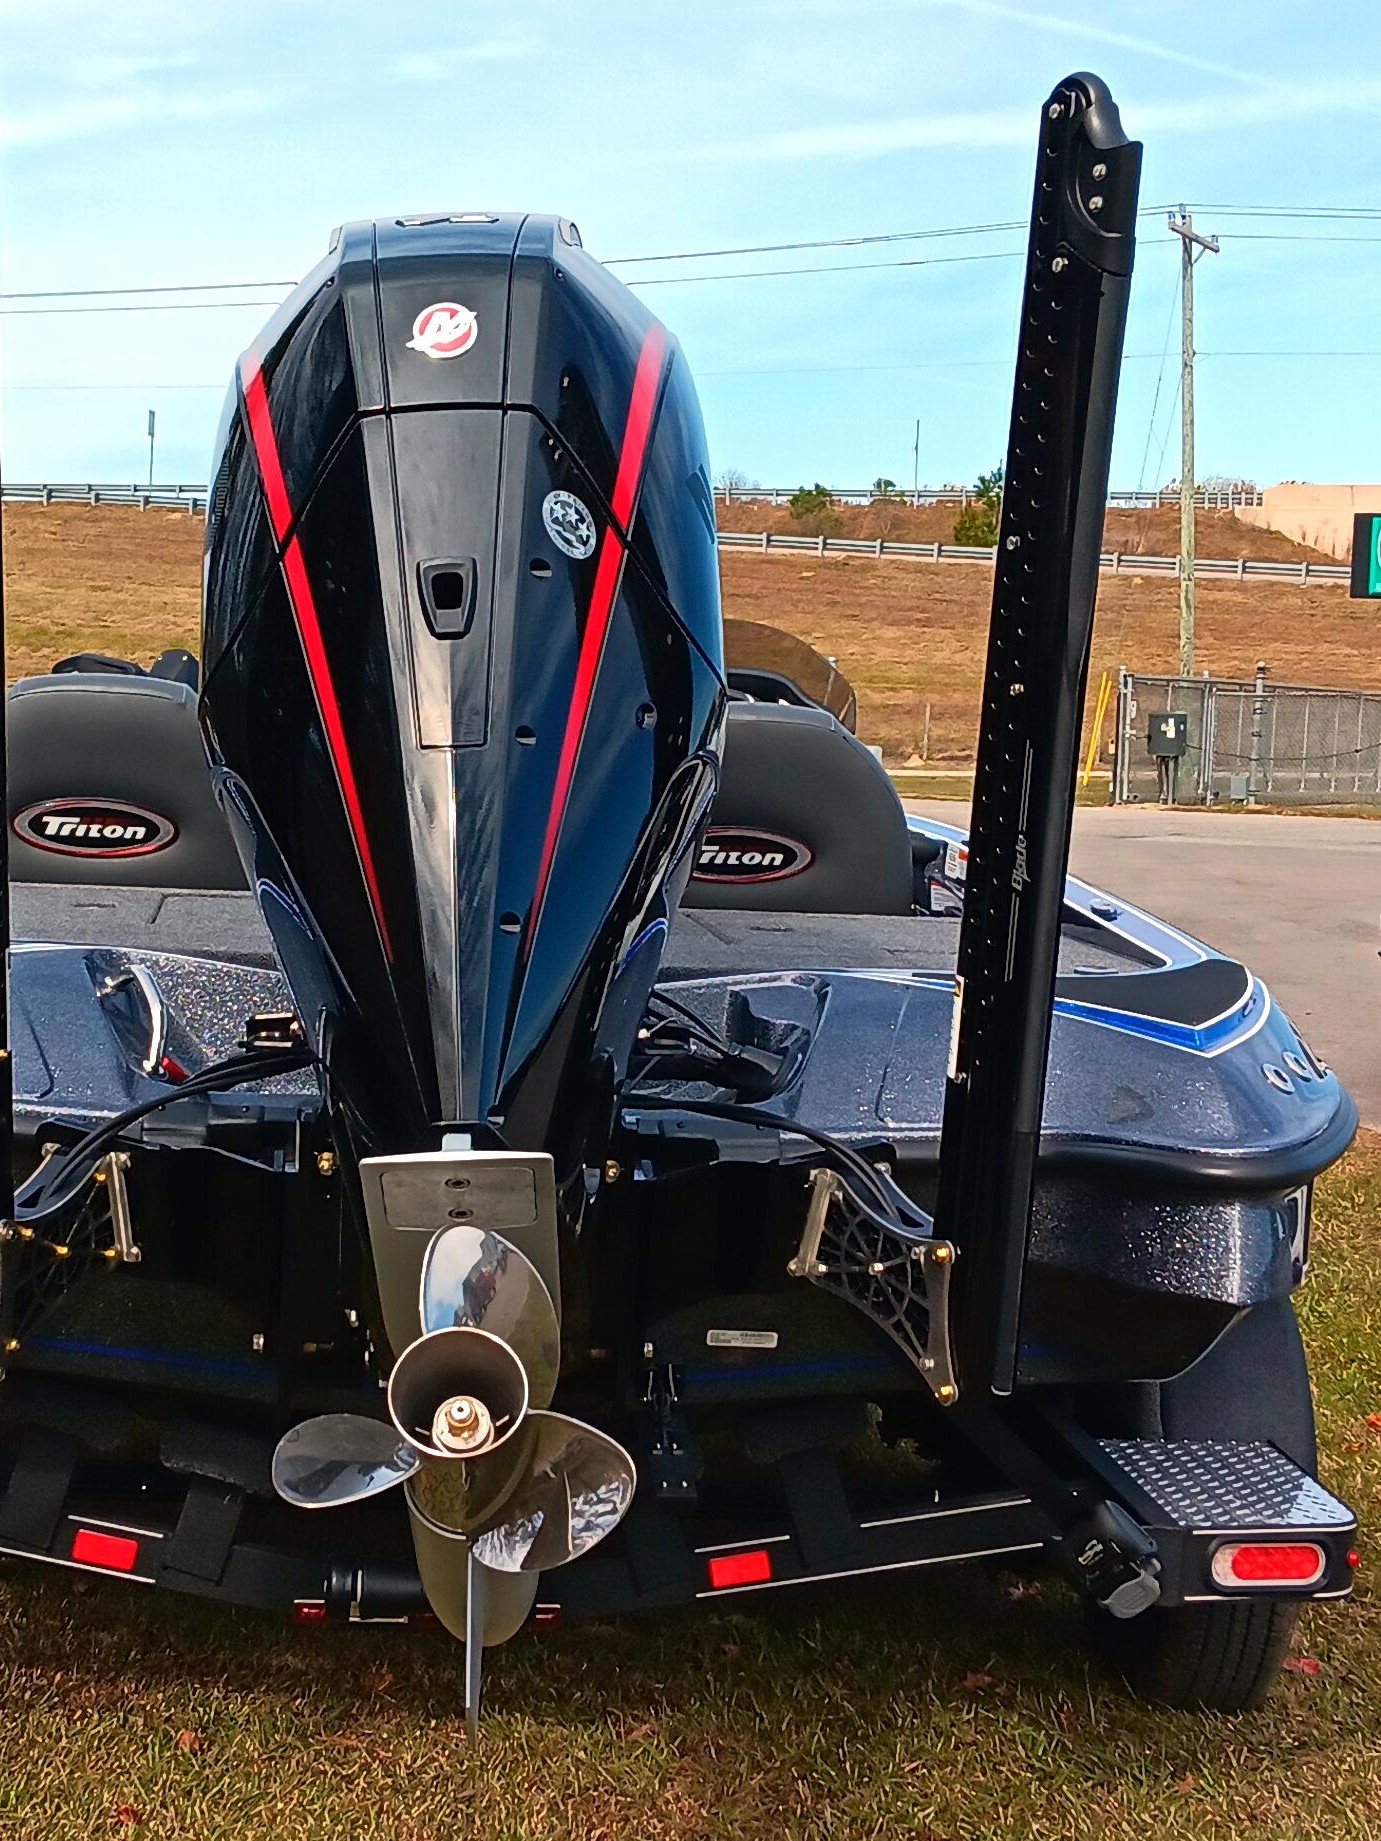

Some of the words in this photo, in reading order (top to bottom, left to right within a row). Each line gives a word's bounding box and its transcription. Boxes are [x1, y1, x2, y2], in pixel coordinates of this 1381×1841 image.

[41, 815, 148, 840] Triton
[699, 845, 784, 866] riton
[1011, 834, 1032, 892] Blade
